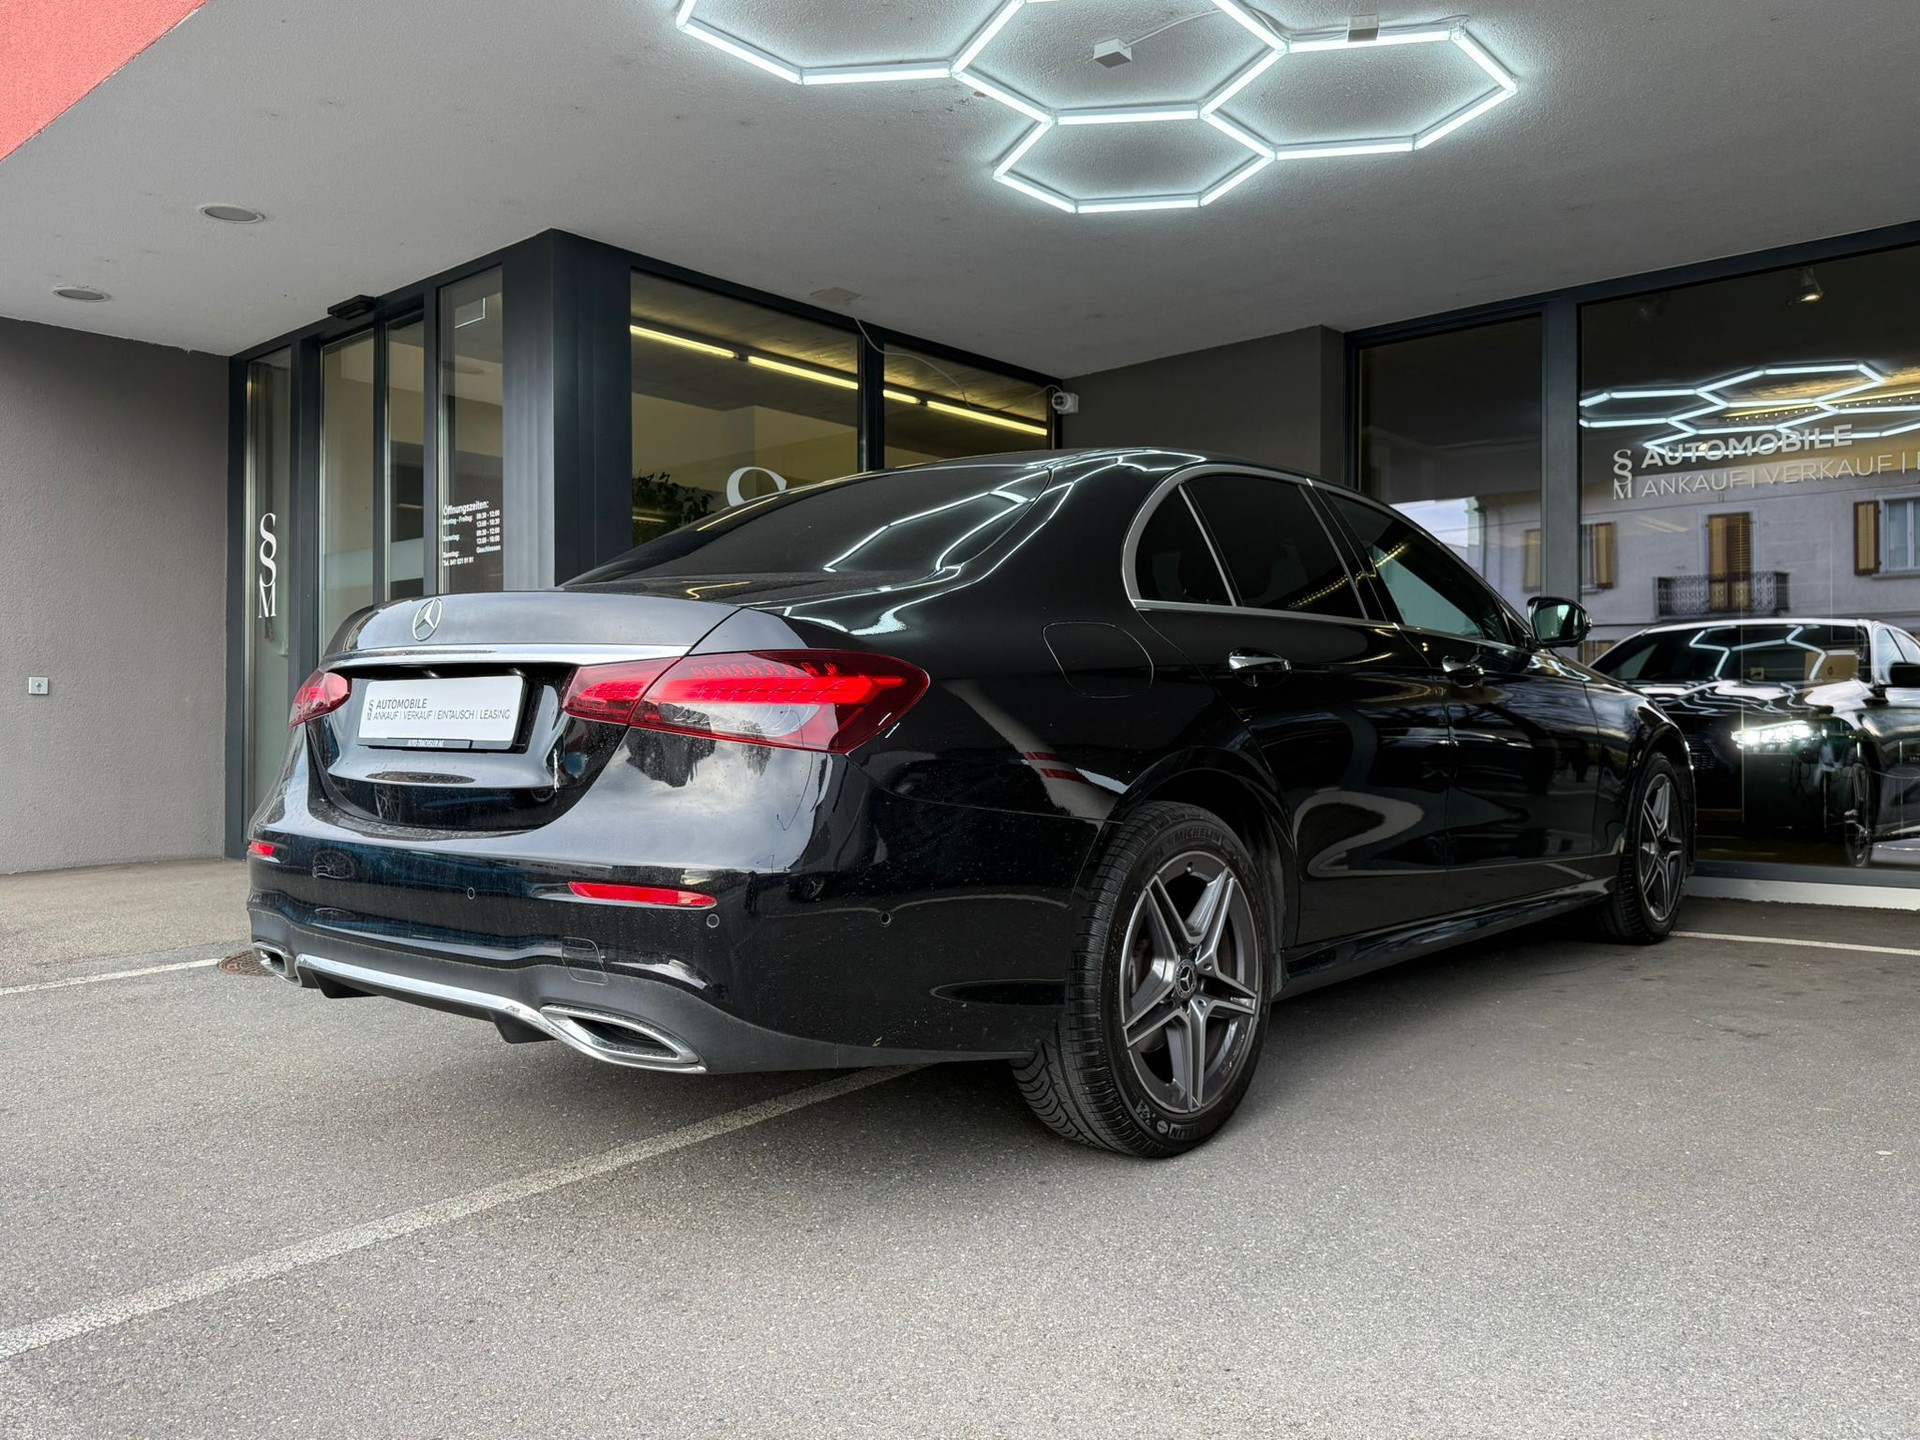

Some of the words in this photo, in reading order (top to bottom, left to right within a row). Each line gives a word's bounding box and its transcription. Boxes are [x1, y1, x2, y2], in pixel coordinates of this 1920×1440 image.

[1641, 423, 1853, 469] AUTOMOBILE
[1641, 470, 1745, 497] ANKAUF
[1763, 454, 1893, 484] VERKAUF
[376, 698, 428, 710] AUTOMOBILE
[373, 710, 399, 721] ANKAUF
[403, 710, 433, 721] VERKAUF
[437, 709, 475, 720] EINTAUSCH
[479, 709, 511, 720] LEASING
[1172, 825, 1223, 846] MICHELIN
